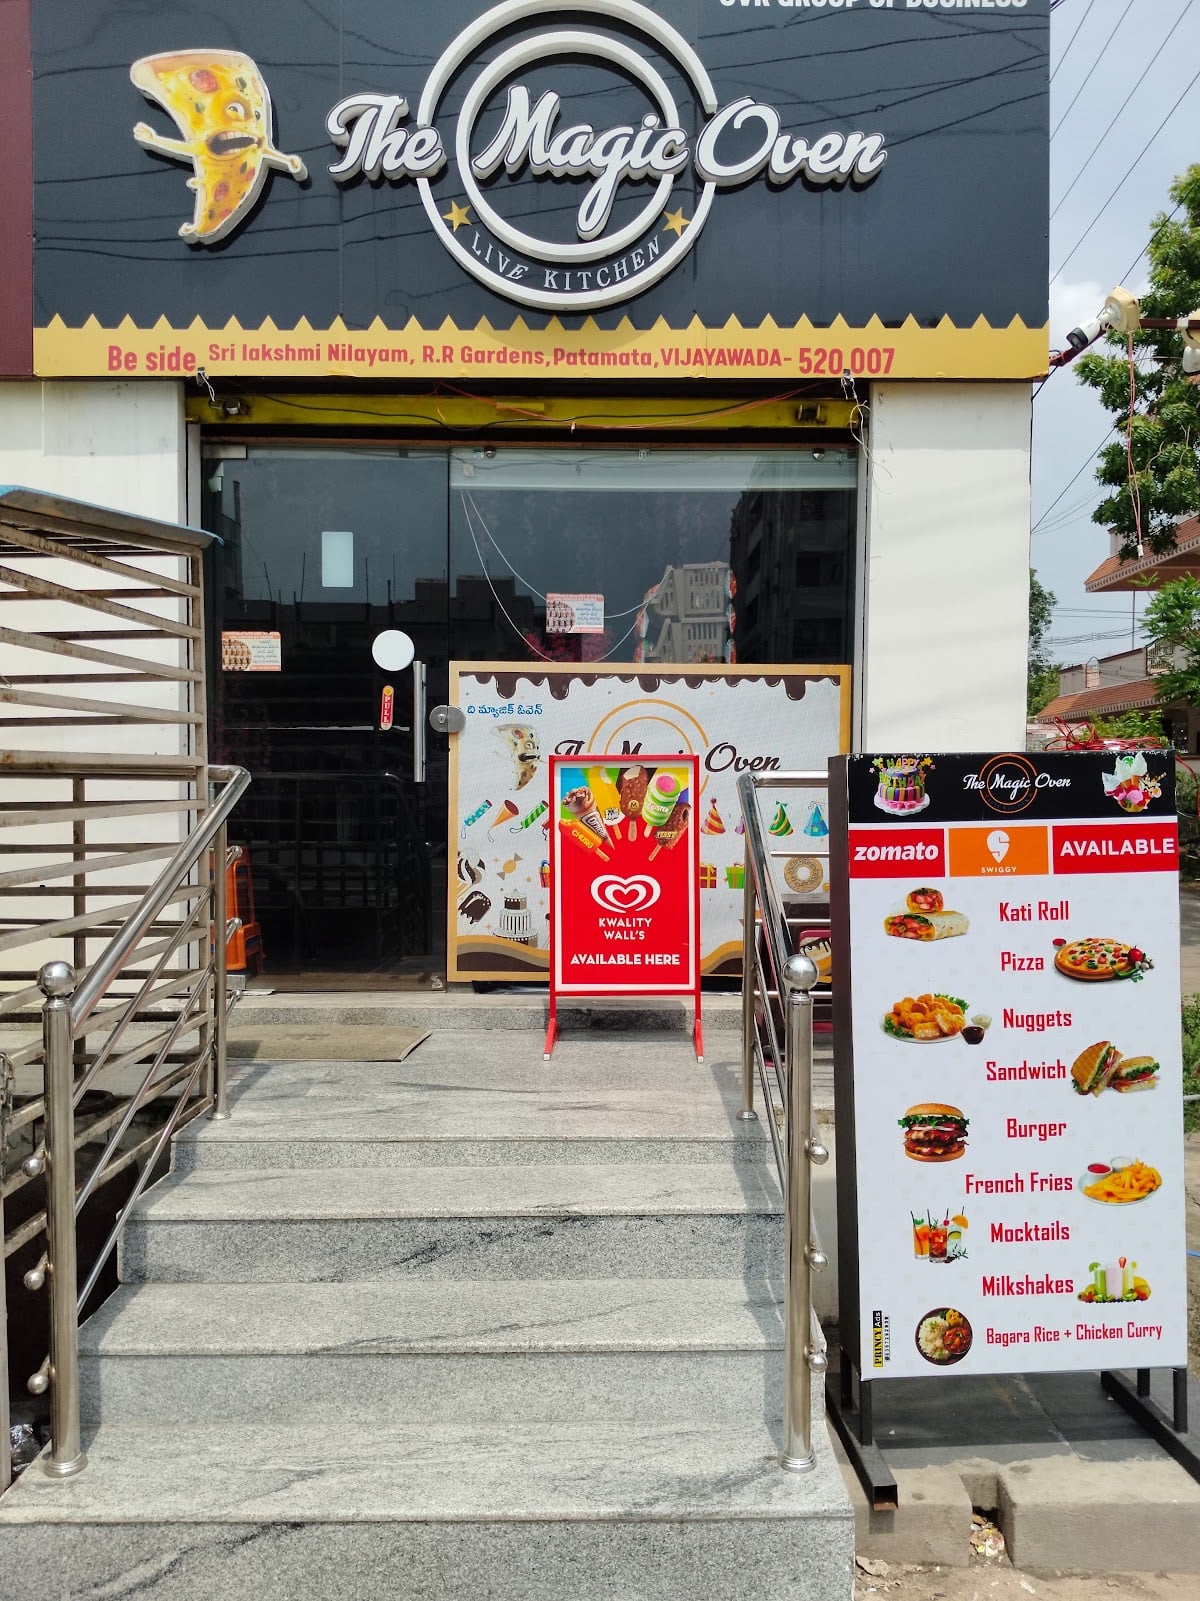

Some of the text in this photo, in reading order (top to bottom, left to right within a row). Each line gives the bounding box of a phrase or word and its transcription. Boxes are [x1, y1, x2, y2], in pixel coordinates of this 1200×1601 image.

[327, 85, 887, 240] The Magic Oven
[471, 230, 660, 290] LIVE KITCHEN
[107, 345, 137, 371] Be
[146, 345, 196, 371] side
[209, 343, 236, 361] Sri
[242, 344, 321, 361] lakshmi
[327, 343, 415, 367] Nilayam,
[422, 345, 454, 363] R.R
[704, 742, 781, 772] Oven
[963, 773, 1072, 801] The Magic Oven
[853, 841, 939, 861] zomato
[1060, 838, 1175, 856] AVAILABLE
[598, 917, 652, 928] KWALITY
[999, 901, 1070, 922] Kati Roll
[603, 930, 646, 941] WALL'S
[570, 953, 681, 965] AVAILABLE HERE
[1001, 952, 1045, 971] Pizza
[1003, 1008, 1072, 1032] Nuggets
[986, 1059, 1067, 1081] Sandwich
[1006, 1118, 1067, 1141] Burger
[965, 1172, 1073, 1194] French Fries
[990, 1220, 1070, 1242] Mocktails
[982, 1274, 1074, 1296] Milkshakes
[986, 1328, 1030, 1347] Bagara
[1034, 1326, 1060, 1342] Rice
[1076, 1323, 1123, 1341] Chicken
[1127, 1322, 1163, 1341] Curry
[874, 1330, 882, 1365] PRINCY
